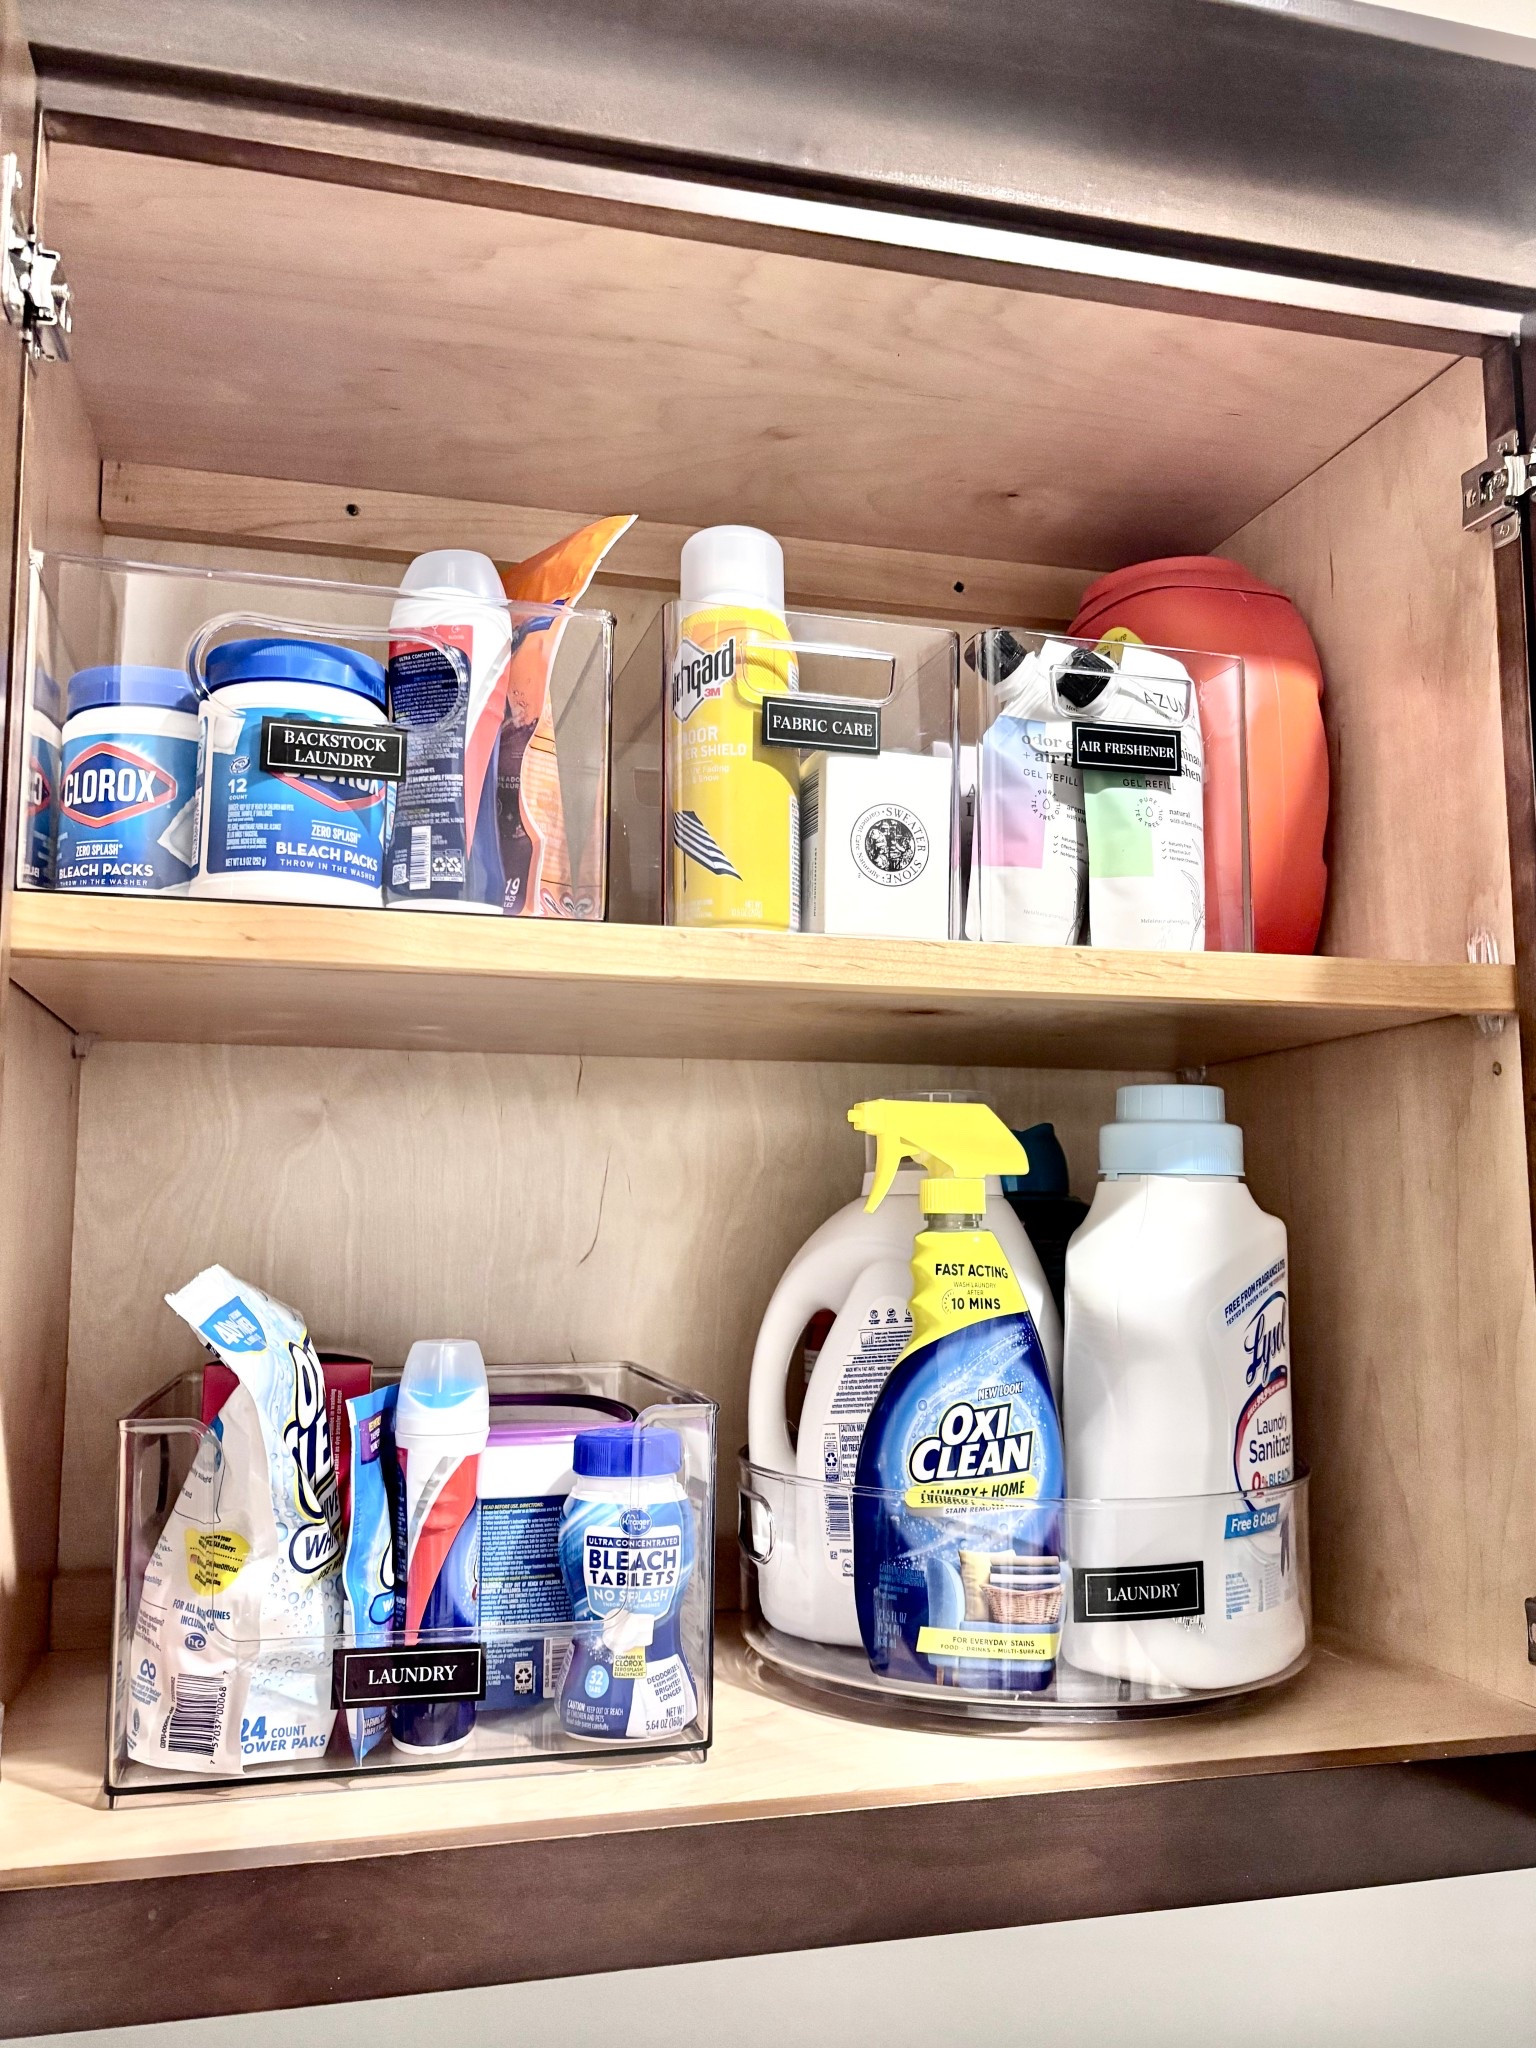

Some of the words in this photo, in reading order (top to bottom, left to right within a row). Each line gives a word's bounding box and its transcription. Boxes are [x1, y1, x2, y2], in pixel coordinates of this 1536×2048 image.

[704, 687, 721, 698] 3M
[772, 714, 828, 733] FABRIC
[832, 720, 873, 737] CARE
[284, 730, 387, 753] BACKSTOCK
[700, 743, 747, 758] SHIELD
[1021, 734, 1062, 750] odor
[1079, 740, 1101, 753] AIR
[1104, 742, 1175, 759] FRESHENER
[294, 749, 376, 768] LAUNDRY
[1034, 750, 1060, 765] air
[227, 778, 248, 794] 12
[1023, 768, 1042, 779] GEL
[1046, 772, 1079, 787] REFILL
[1122, 778, 1142, 788] GEL
[1145, 779, 1177, 791] REFILL
[63, 768, 157, 807] CLOROX
[310, 824, 332, 839] ZERO
[75, 844, 91, 857] ZERO
[275, 841, 341, 861] BLEACH
[344, 850, 379, 873] PACKS
[58, 863, 98, 879] BLEACH
[102, 863, 154, 877] PACKS
[280, 858, 314, 869] THROW
[318, 862, 329, 871] IN
[332, 863, 348, 875] THE
[350, 868, 376, 882] WASHER
[935, 1263, 965, 1276] FAST
[967, 1264, 1009, 1279] ACTING
[951, 1297, 965, 1310] 10
[969, 1297, 1001, 1310] MINS
[1224, 1297, 1241, 1319] FREE
[1240, 1283, 1256, 1303] FROM
[1244, 1301, 1287, 1387] Lysol
[977, 1385, 998, 1401] NEW
[999, 1381, 1024, 1398] LOOK!
[941, 1402, 1010, 1446] OXI
[1256, 1413, 1288, 1435] Laundry
[910, 1433, 1033, 1481] CLEAN
[1249, 1432, 1292, 1464] Sanitizer
[991, 1480, 1026, 1498] HOME
[944, 1507, 967, 1515] STAIN
[1230, 1517, 1252, 1533] Free
[1252, 1513, 1259, 1527] &
[1259, 1510, 1278, 1526] Clear
[588, 1537, 614, 1547] ULTRA
[589, 1549, 677, 1572] BLEACH
[589, 1570, 675, 1587] TABLETS
[593, 1589, 615, 1601] NO
[1106, 1583, 1181, 1602] LAUNDRY
[172, 1599, 185, 1611] FOR
[184, 1602, 196, 1614] ALL
[952, 1636, 968, 1644] FOR
[970, 1637, 1008, 1647] EVERYDAY
[1010, 1639, 1035, 1647] STAINS
[614, 1659, 643, 1668] CLOROX
[368, 1664, 459, 1685] LAUNDRY
[589, 1670, 604, 1685] 32
[646, 1663, 680, 1685] DEODORIZES
[666, 1707, 676, 1718] NET
[240, 1715, 267, 1742] 24
[271, 1724, 307, 1738] COUNT
[645, 1719, 660, 1731] 5.64
[660, 1718, 668, 1729] OZ
[240, 1739, 287, 1754] OWER
[291, 1734, 326, 1749] PAKS
